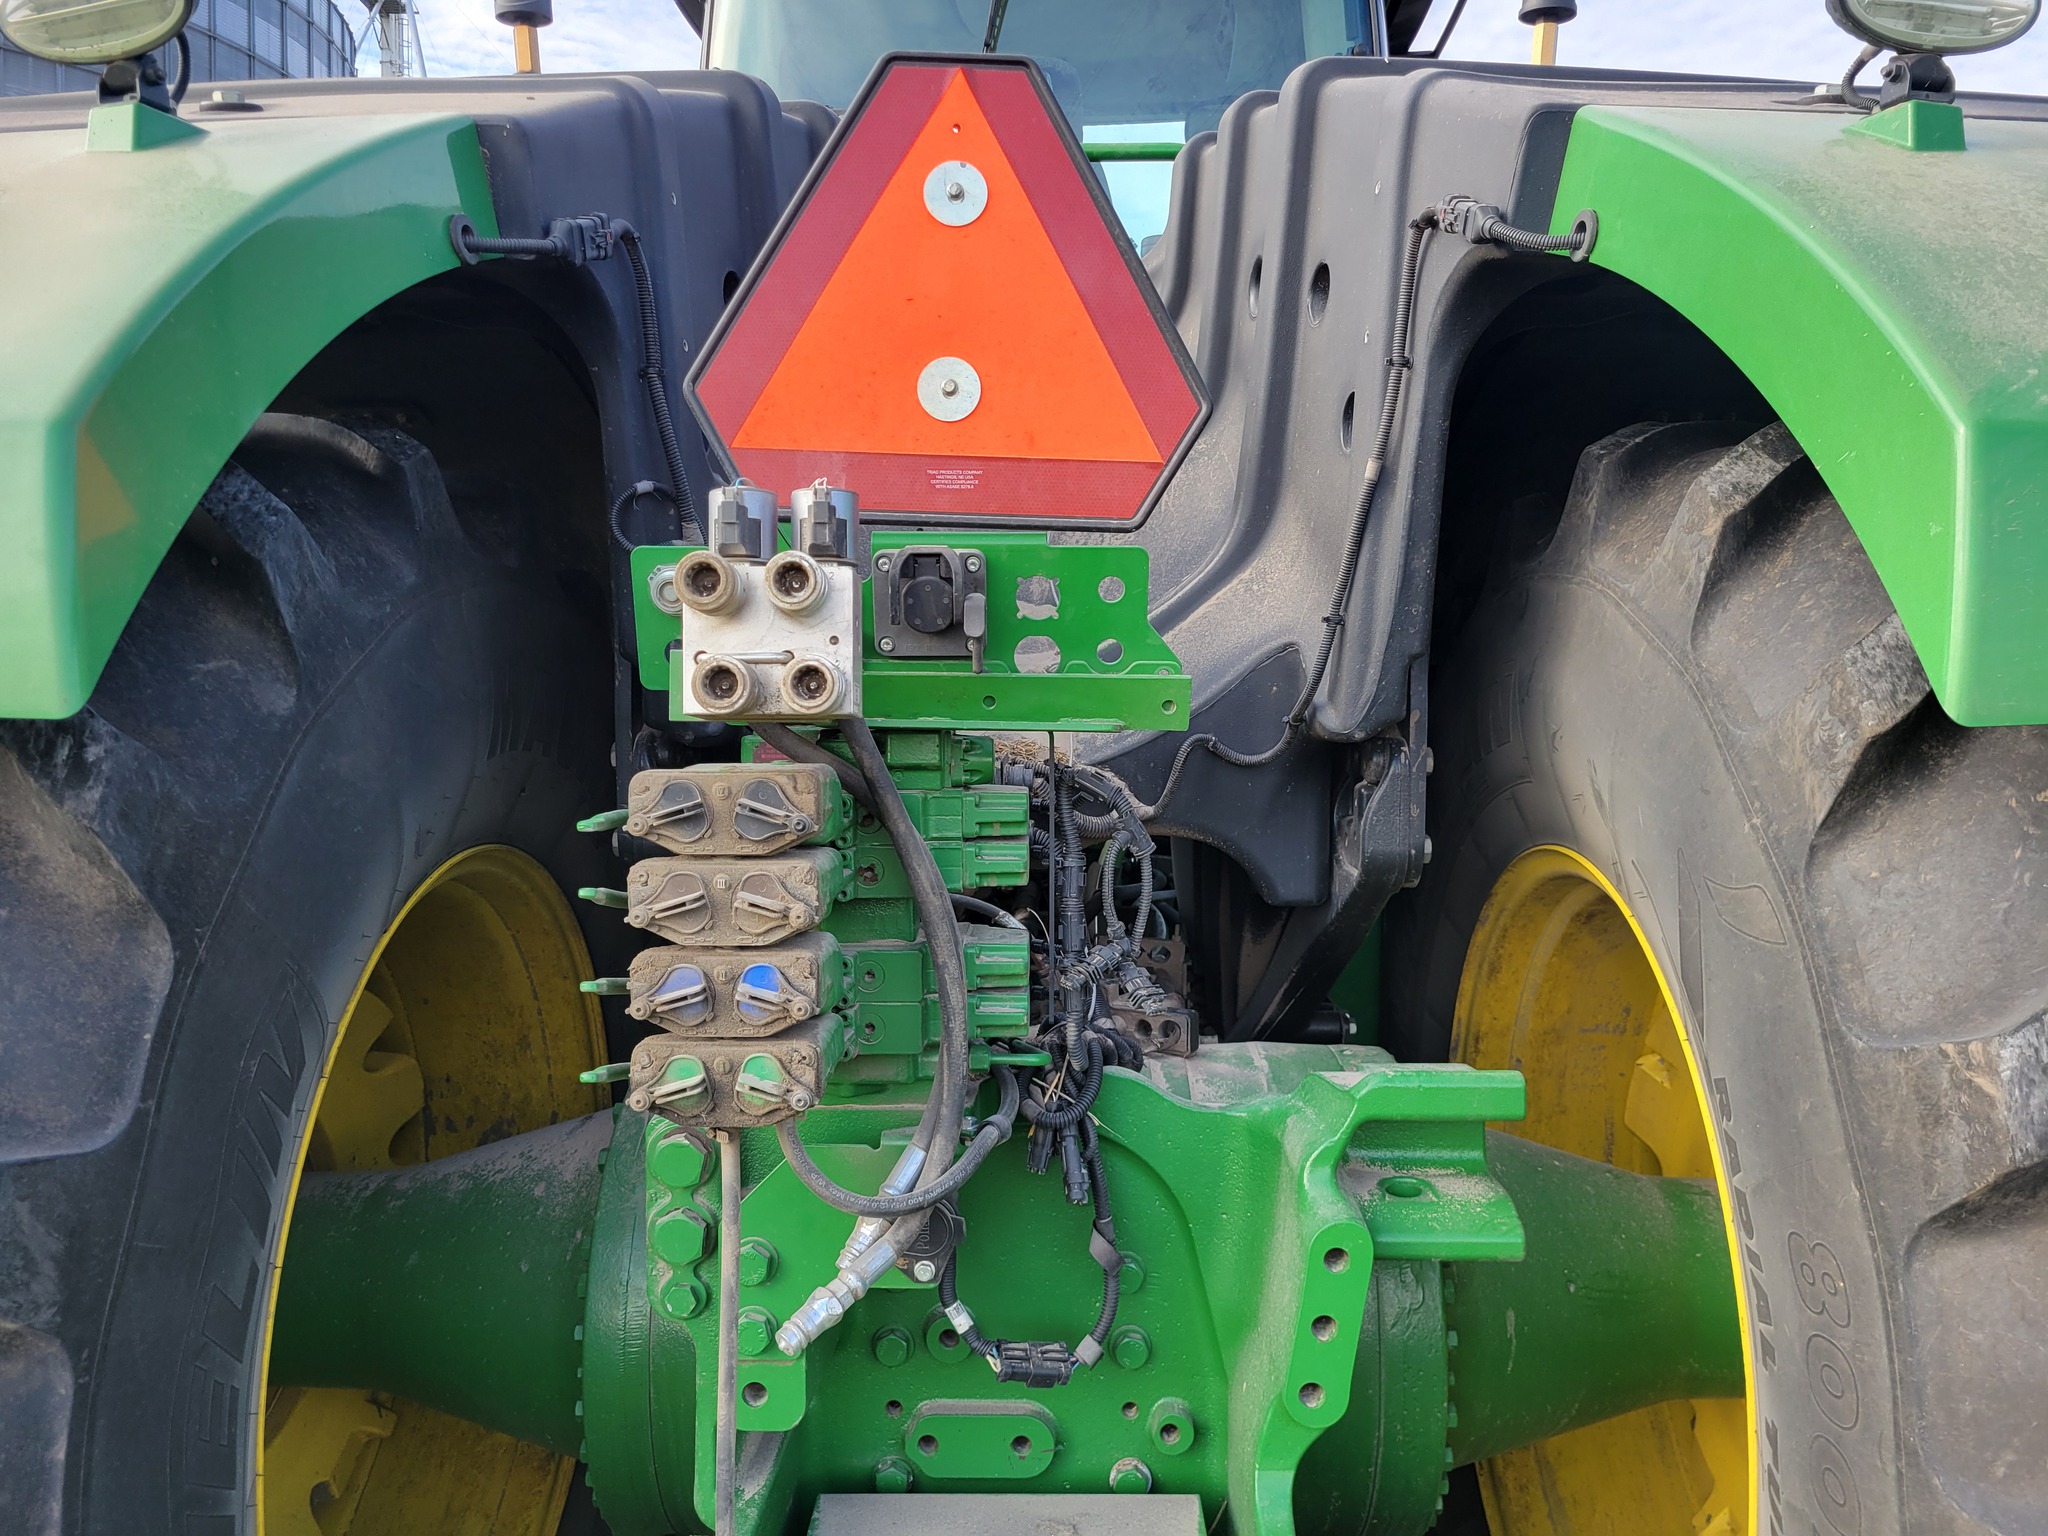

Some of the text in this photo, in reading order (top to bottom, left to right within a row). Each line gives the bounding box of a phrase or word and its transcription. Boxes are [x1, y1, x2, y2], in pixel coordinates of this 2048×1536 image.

[828, 571, 835, 581] 2
[184, 988, 307, 1536] ELIN
[1712, 1075, 1778, 1374] RADIAL
[1764, 1415, 1785, 1536] TU
[1786, 1230, 1863, 1536] 800
